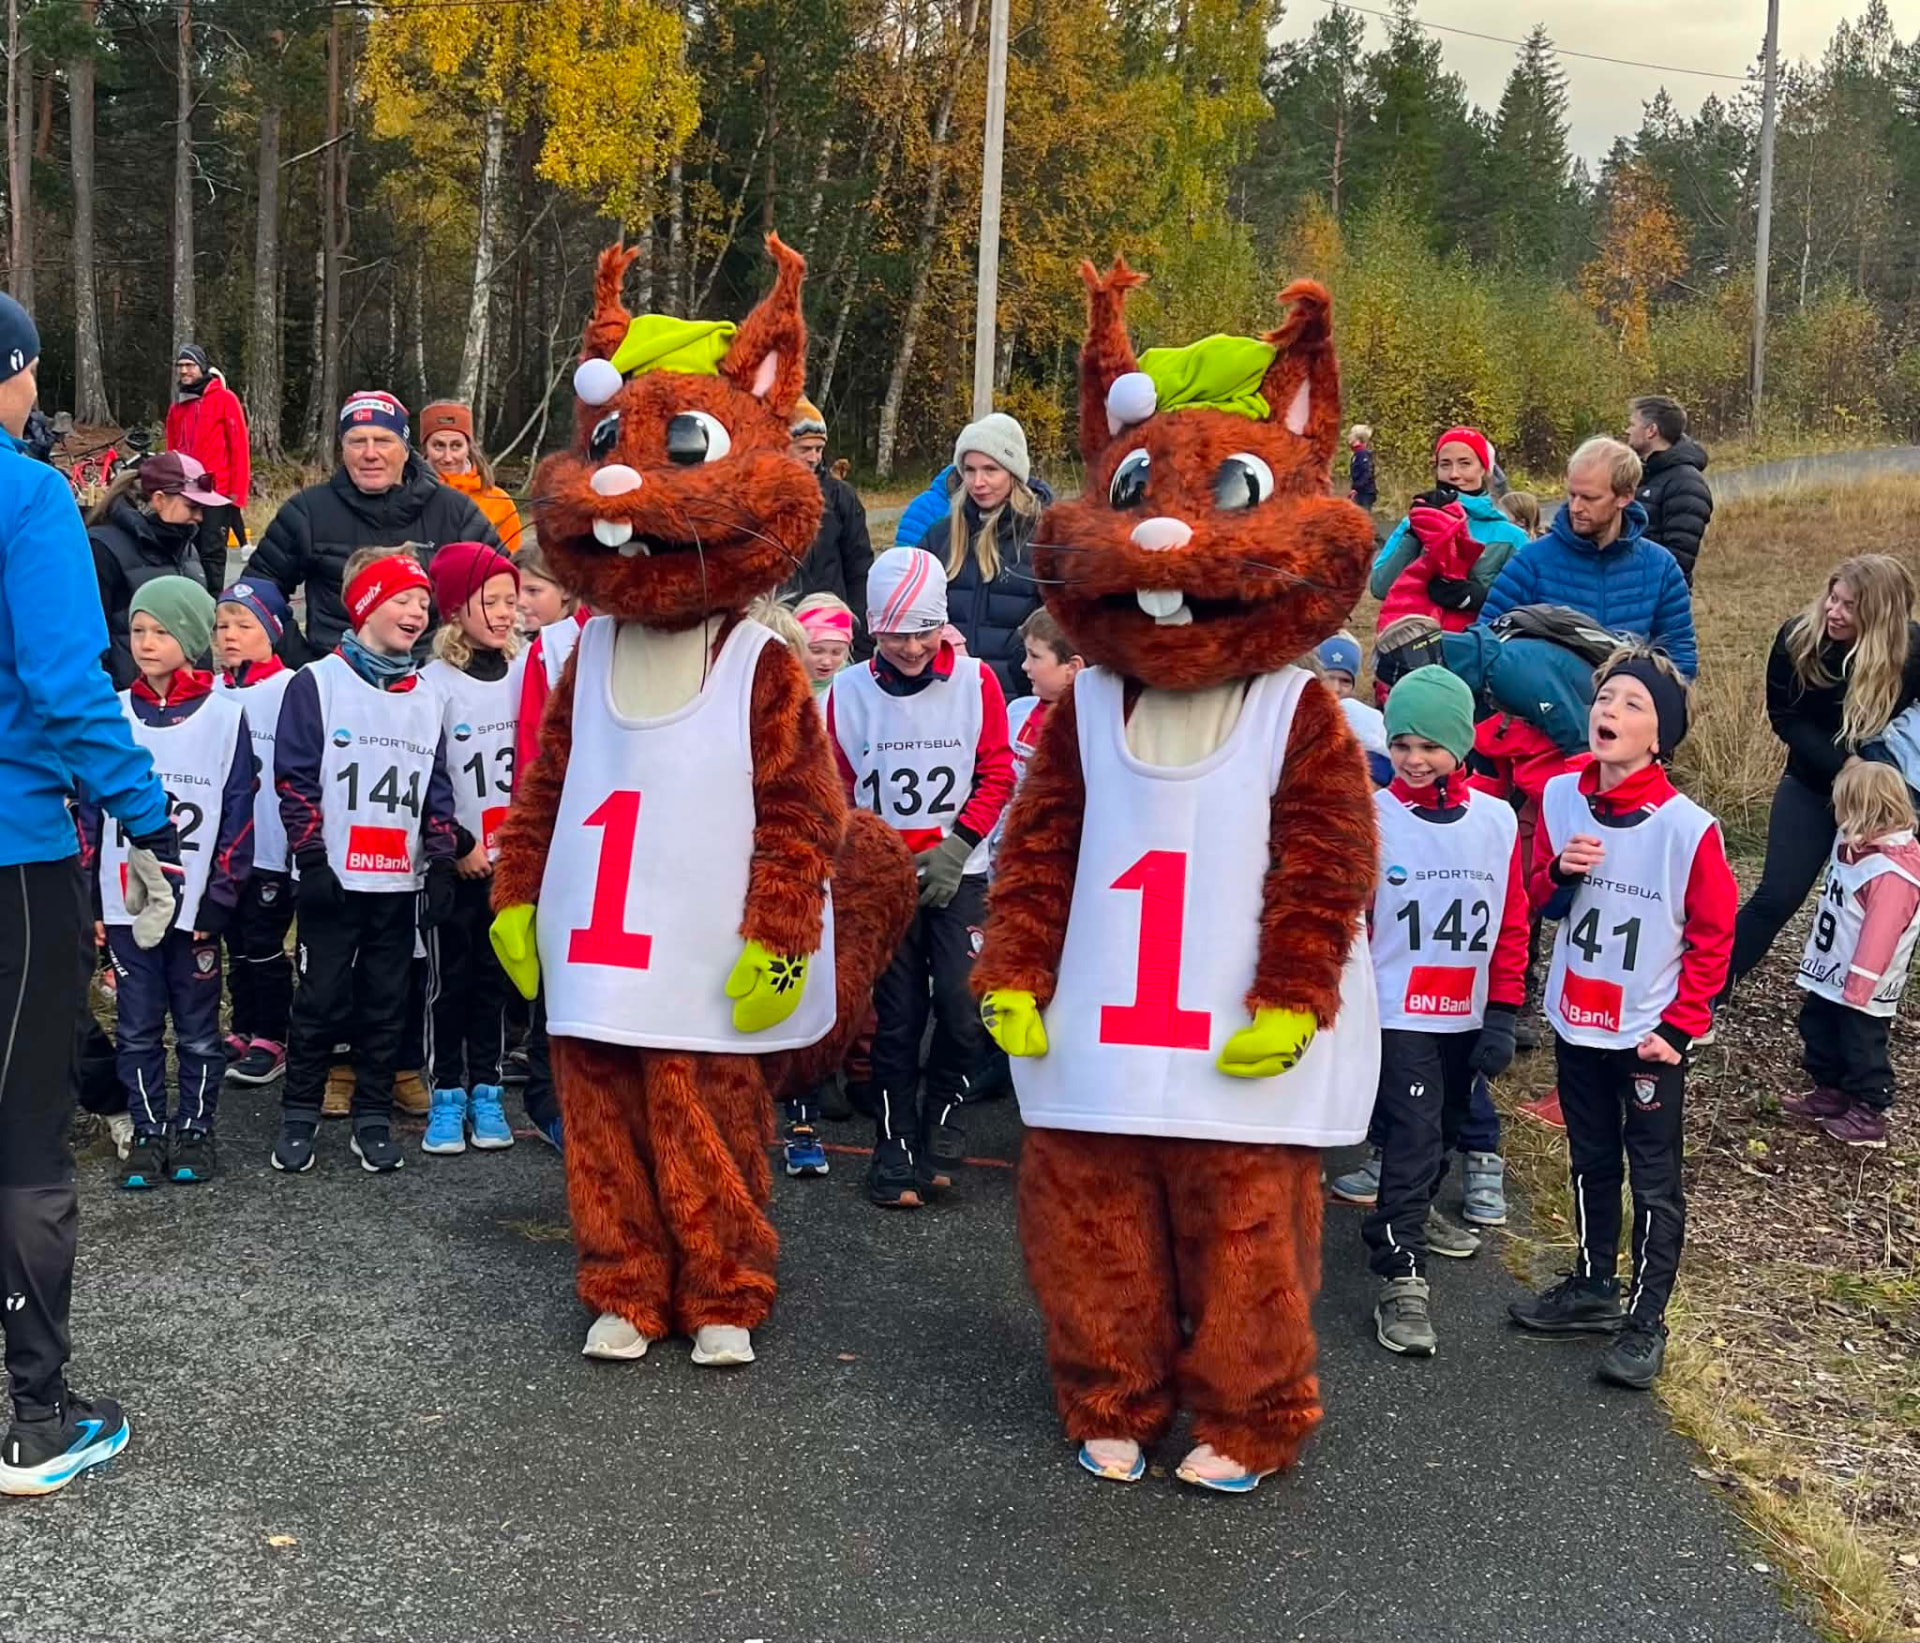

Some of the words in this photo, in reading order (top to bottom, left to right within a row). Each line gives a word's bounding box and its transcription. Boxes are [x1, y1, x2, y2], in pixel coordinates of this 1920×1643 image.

[876, 738, 963, 752] SPORTSBUA
[336, 762, 421, 819] 144
[463, 746, 516, 798] 13
[862, 765, 956, 817] 132
[349, 852, 374, 869] BN
[375, 853, 409, 871] Bank
[486, 832, 497, 847] B
[567, 790, 653, 970] 1
[1099, 849, 1211, 1050] 1
[1396, 898, 1491, 952] 142
[1566, 907, 1642, 972] 41
[1814, 909, 1837, 954] 9
[1409, 994, 1436, 1011] BN
[1569, 1004, 1616, 1030] Bank
